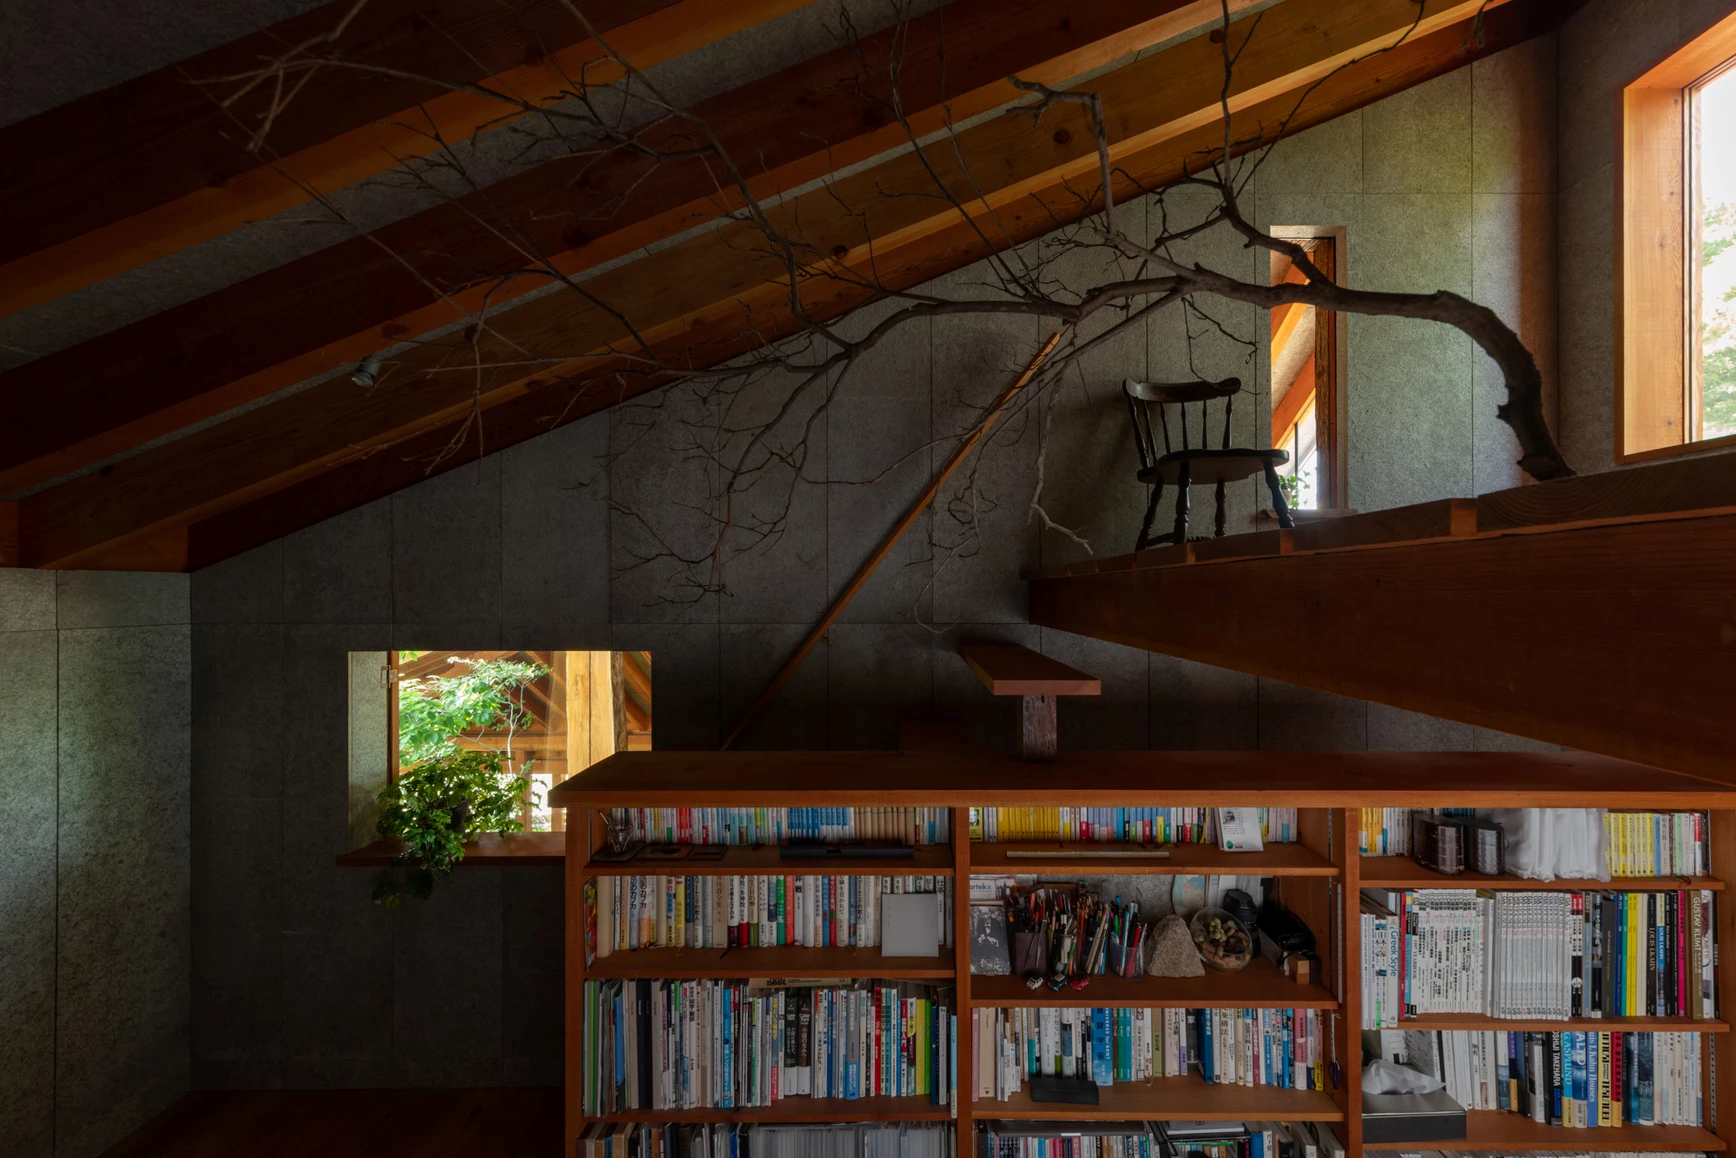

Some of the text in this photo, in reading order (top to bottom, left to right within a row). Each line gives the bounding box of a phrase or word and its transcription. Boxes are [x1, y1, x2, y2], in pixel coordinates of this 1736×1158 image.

[640, 875, 648, 909] 辺のカフカ
[1693, 897, 1702, 951] GUSTAV KLIMT
[1389, 931, 1399, 977] Greek Style
[1552, 1031, 1561, 1087] OSHIJI TAKEHARA
[1564, 1041, 1573, 1085] ASPLUND
[1576, 1032, 1587, 1066] ALTO
[1589, 1051, 1597, 1072] Kahn
[1589, 1073, 1597, 1103] Houses
